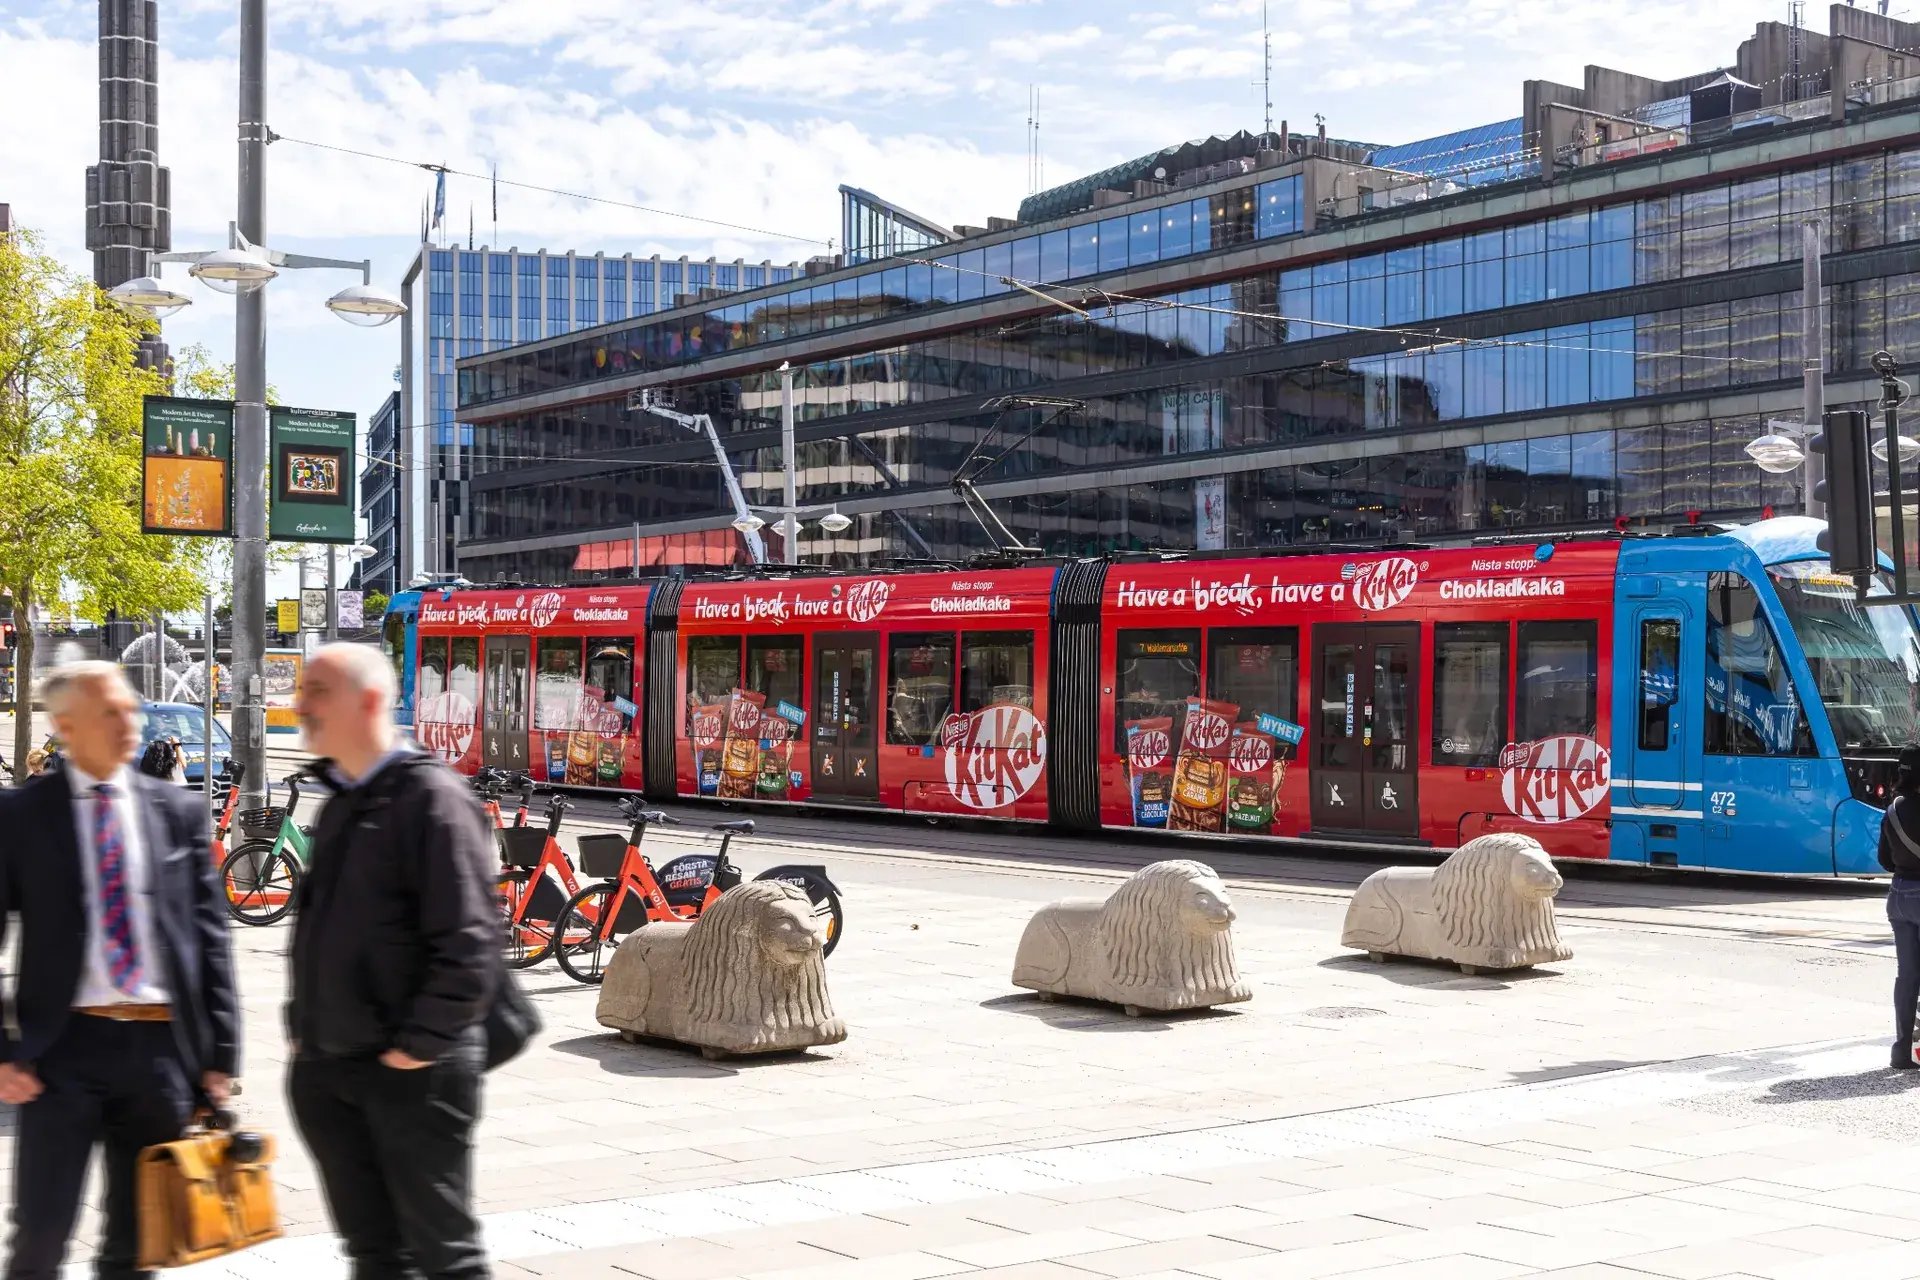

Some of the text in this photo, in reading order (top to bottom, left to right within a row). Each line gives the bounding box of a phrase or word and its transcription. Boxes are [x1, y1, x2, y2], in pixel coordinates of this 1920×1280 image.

[161, 408, 182, 416] Modern
[1471, 558, 1538, 572] Nästa stopp:
[951, 581, 994, 591] Nästa stopp:
[1117, 580, 1169, 607] Have
[1172, 589, 1186, 606] a
[1191, 574, 1263, 611] break,
[1271, 576, 1328, 603] have
[1331, 584, 1345, 602] a
[1358, 558, 1416, 610] KitKat
[1439, 576, 1565, 599] Chokladkaka
[695, 597, 728, 618] Have
[731, 603, 740, 618] a
[743, 591, 789, 622] break,
[794, 593, 829, 617] have
[832, 600, 843, 615] a
[849, 580, 888, 621] KitKat
[930, 594, 1011, 613] Chokladkaka
[422, 603, 448, 622] Have
[448, 609, 456, 622] a
[457, 600, 490, 625] break,
[493, 602, 518, 622] have
[520, 607, 529, 621] a
[573, 607, 629, 622] Chokladkaka
[1139, 643, 1145, 653] 7
[732, 701, 759, 730] KitKat
[779, 702, 803, 721] NYHET
[1188, 715, 1228, 748] KitKat
[1262, 716, 1299, 740] NYHET
[954, 707, 1043, 807] KitKat
[1133, 731, 1169, 768] KitKat
[1233, 738, 1270, 772] KitKat
[1513, 738, 1608, 822] KitKat
[1182, 788, 1209, 804] CARAMEL
[1186, 783, 1207, 796] SALTED
[1144, 803, 1163, 811] DOUBLE
[1710, 791, 1736, 807] 472
[1141, 810, 1168, 819] CHOCOLATE
[1234, 811, 1261, 823] HAZELNUT
[1712, 806, 1722, 814] C2
[673, 860, 708, 873] FÖRSTA
[665, 870, 696, 883] RESAN
[670, 877, 702, 889] GRATIS
